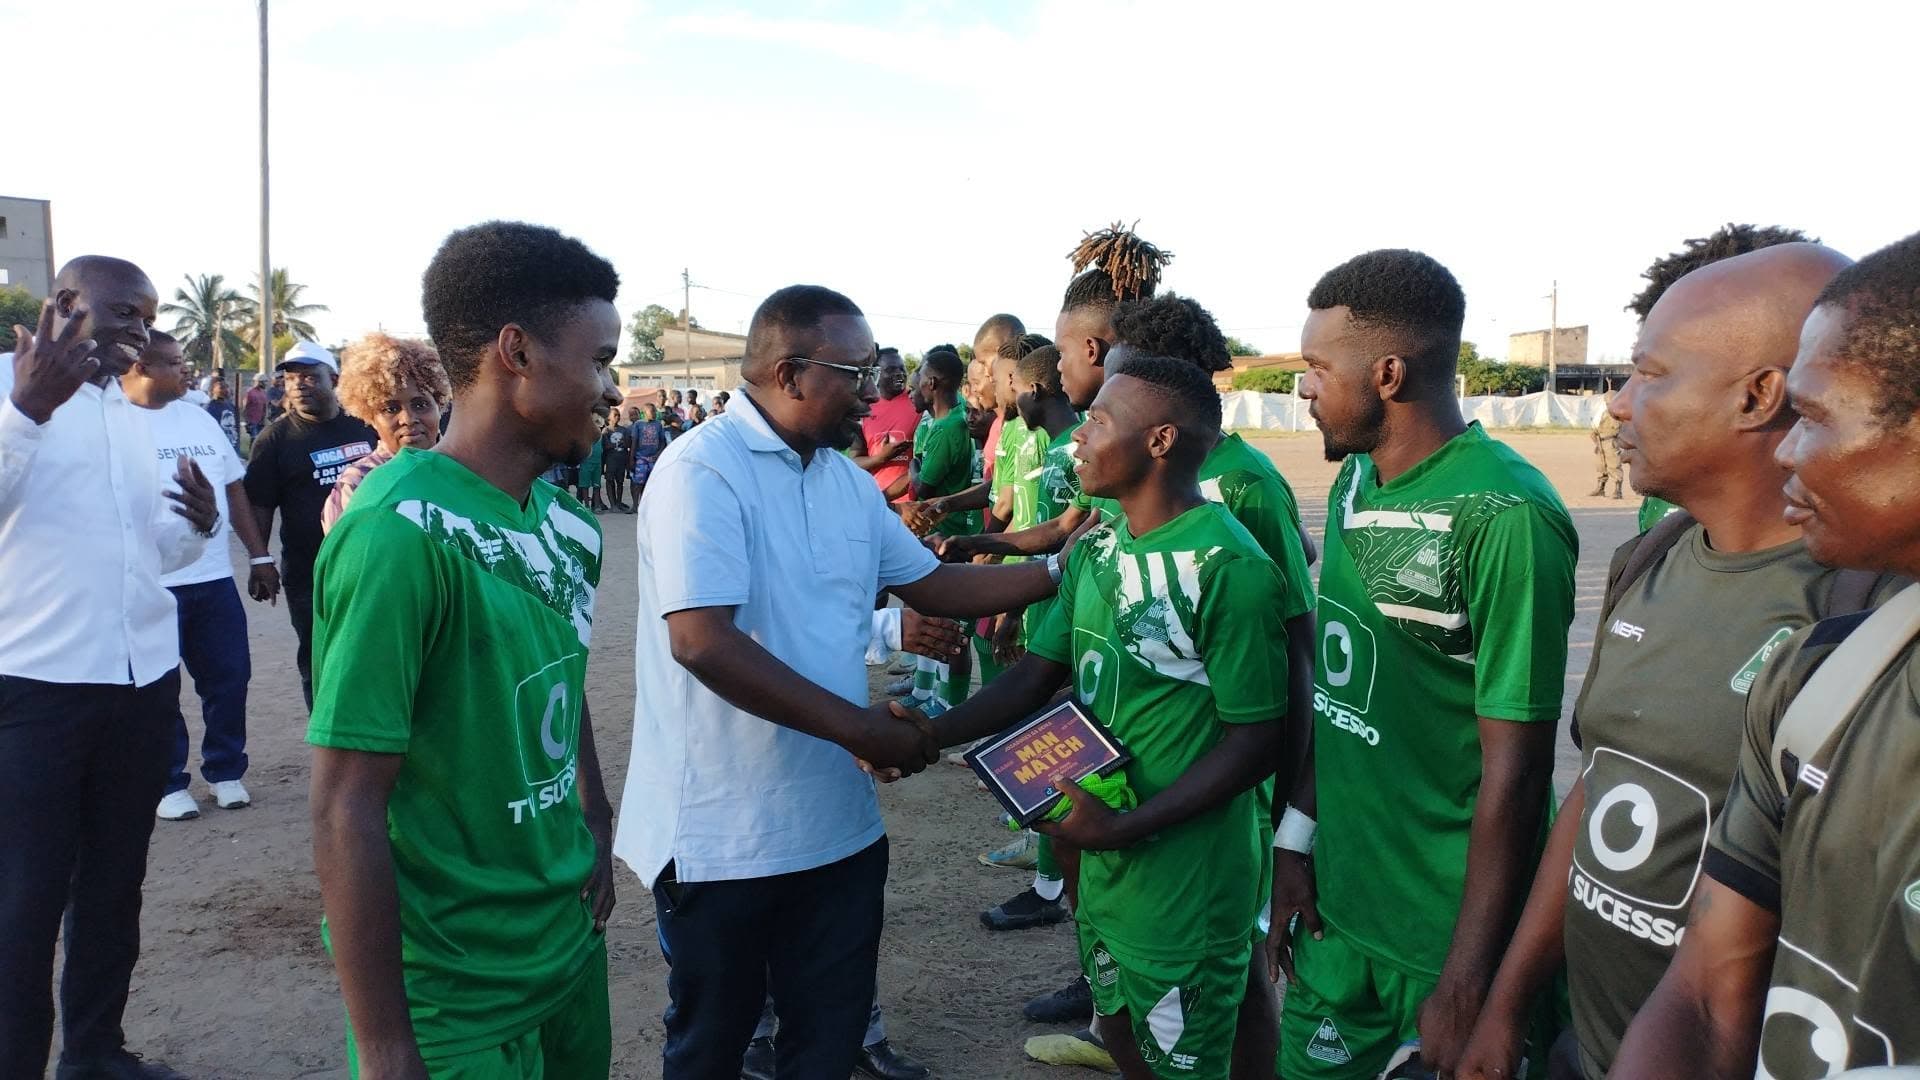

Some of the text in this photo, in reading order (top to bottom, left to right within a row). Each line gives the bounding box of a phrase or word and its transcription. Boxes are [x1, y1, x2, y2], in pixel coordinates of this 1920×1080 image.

[315, 444, 371, 465] JOGA BETS
[322, 467, 336, 477] DE
[1013, 735, 1086, 785] MATCH
[1015, 731, 1060, 763] MAN
